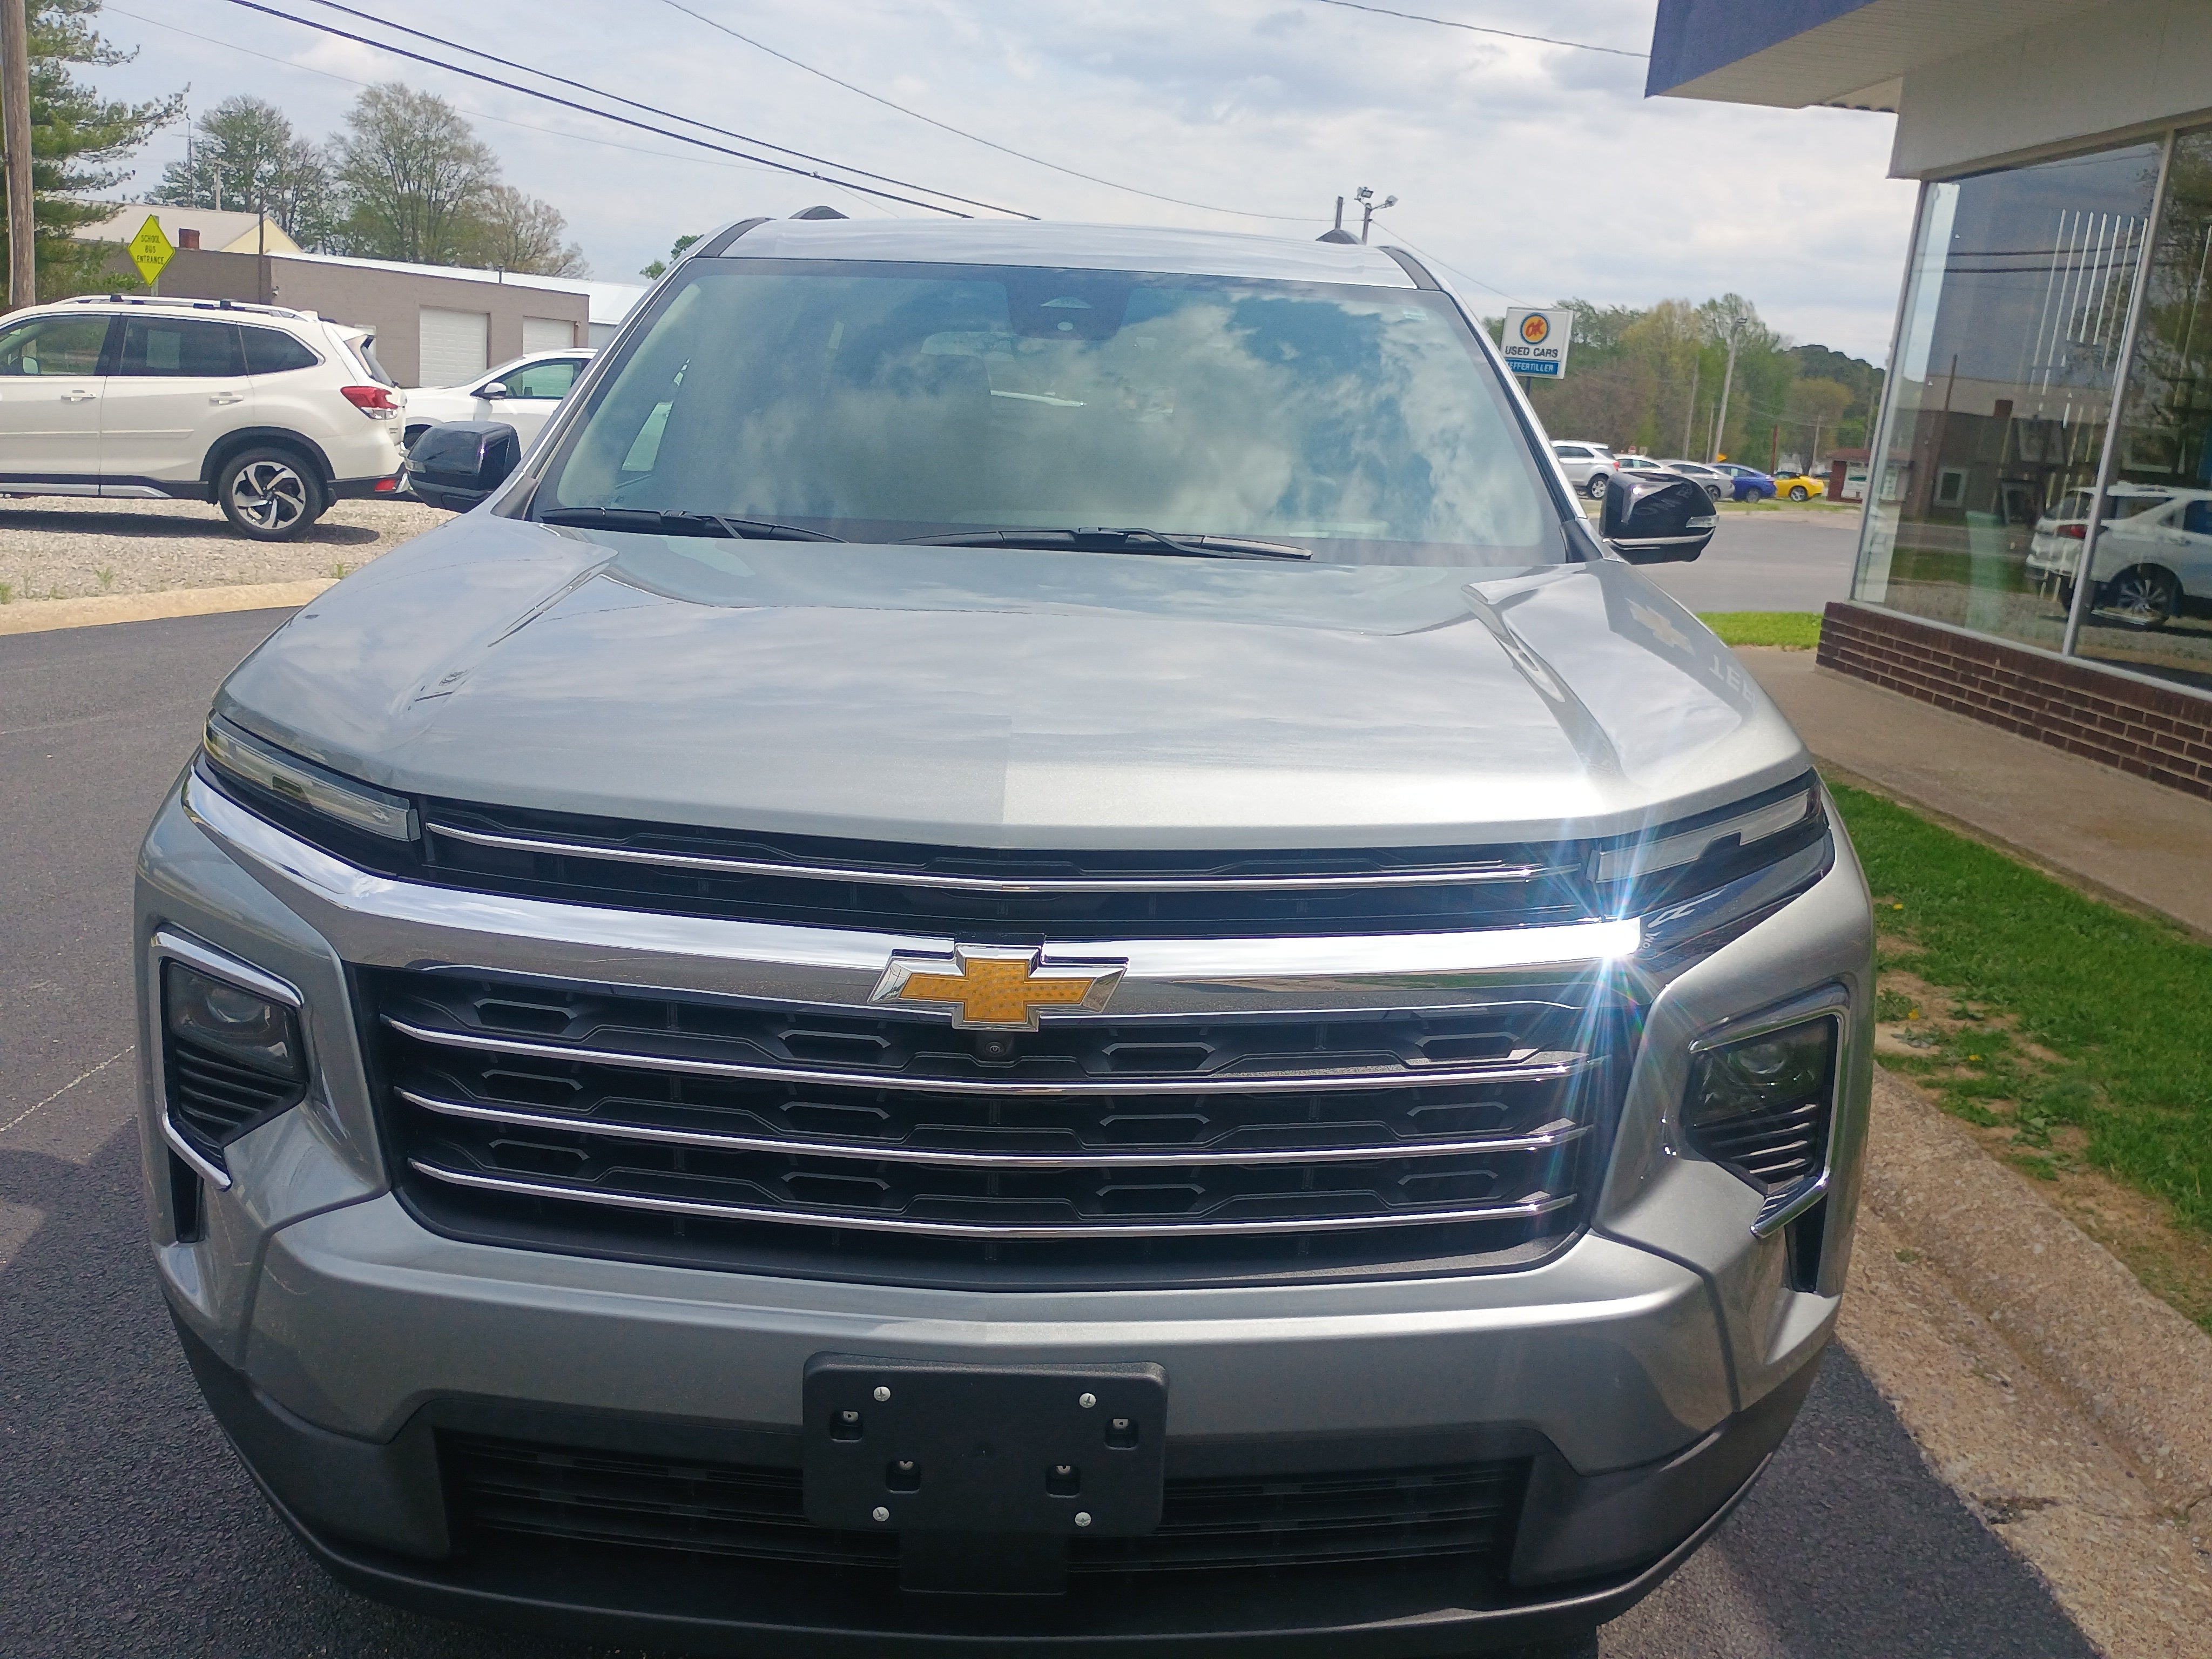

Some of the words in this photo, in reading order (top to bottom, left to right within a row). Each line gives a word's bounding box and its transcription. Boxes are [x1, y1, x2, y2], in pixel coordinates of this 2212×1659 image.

[141, 234, 160, 243] SCHOOL
[145, 245, 156, 253] BUS
[137, 255, 164, 265] ENTRANCE
[1505, 346, 1530, 356] USED
[1533, 347, 1558, 358] CARS
[1507, 361, 1554, 372] EFFERTILLER
